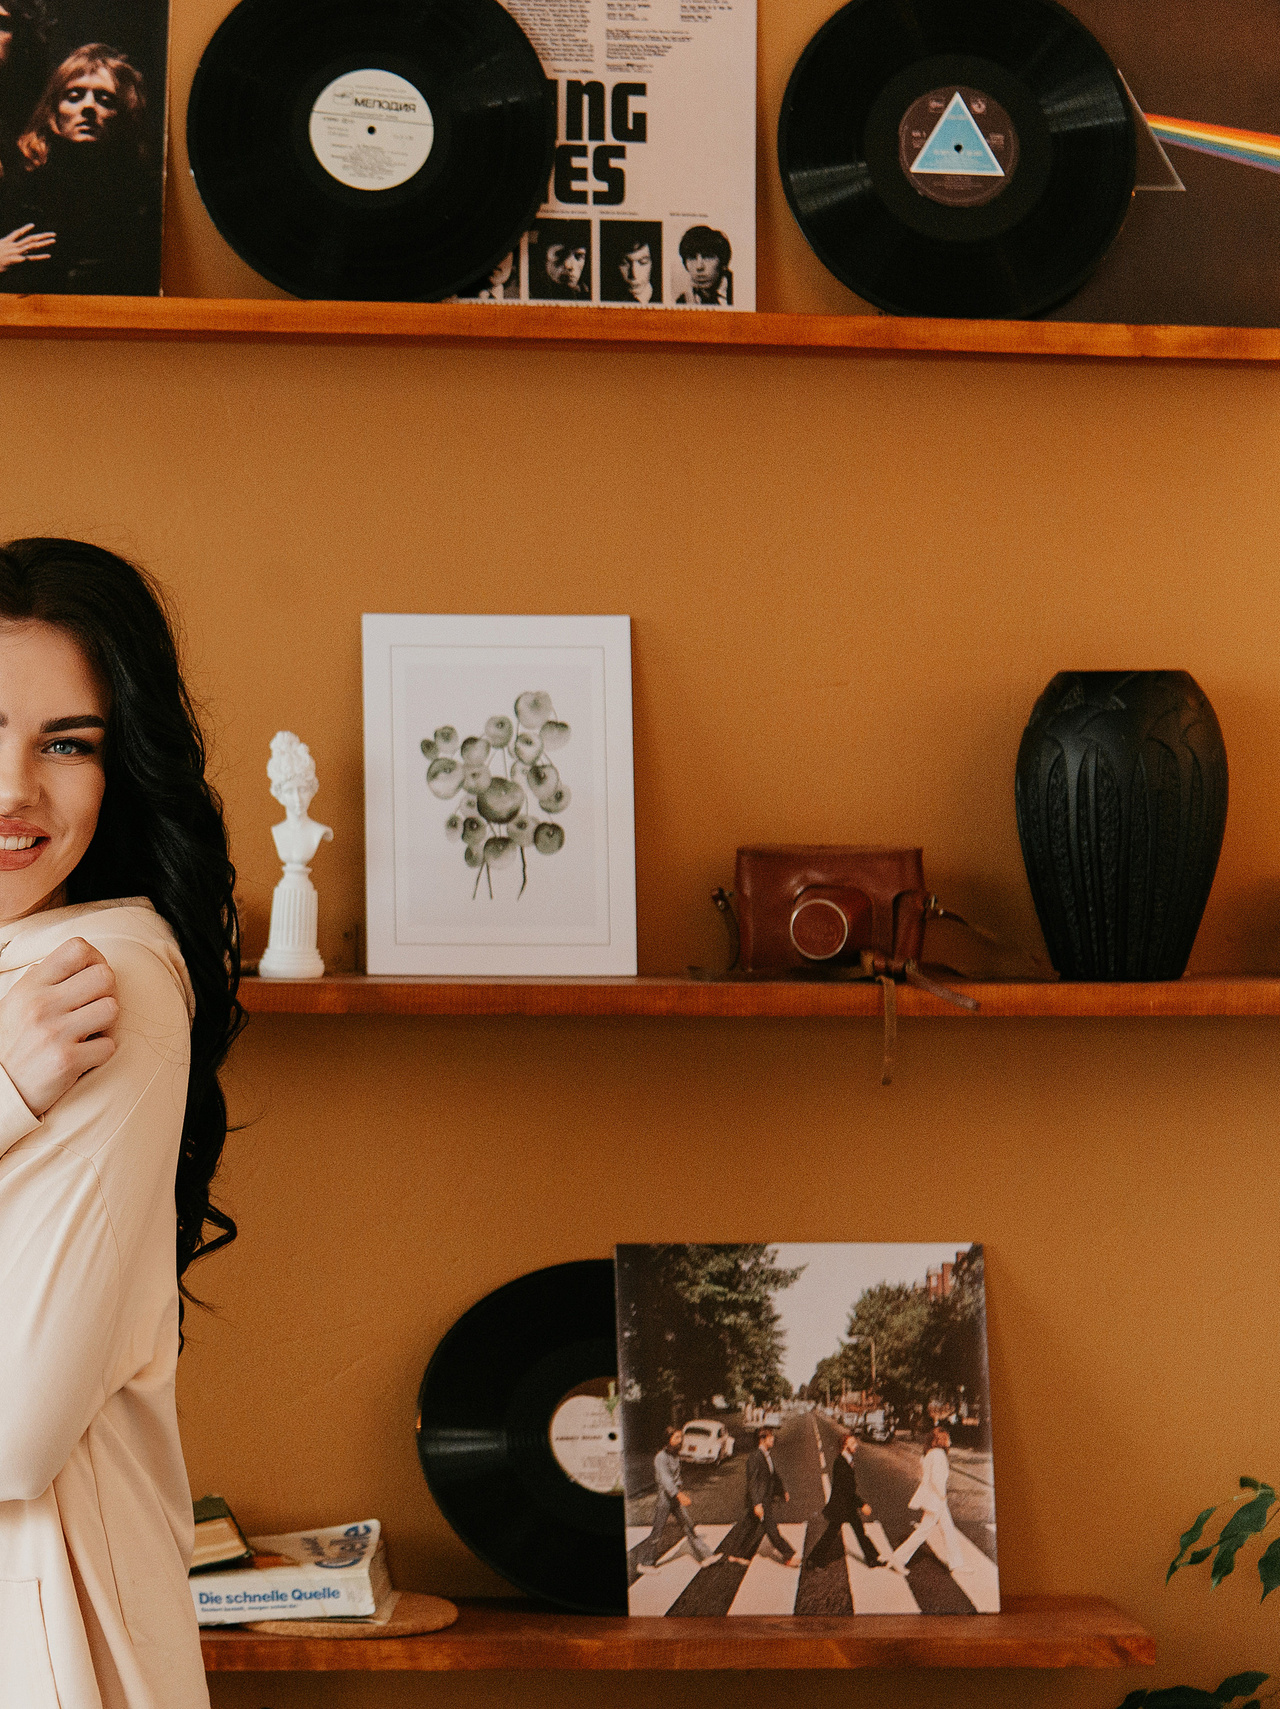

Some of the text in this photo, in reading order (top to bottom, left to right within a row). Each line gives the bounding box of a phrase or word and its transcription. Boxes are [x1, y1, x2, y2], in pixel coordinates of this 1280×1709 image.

[354, 97, 417, 113] МЕЛОДИЯ
[199, 1587, 340, 1604] Die schnelle Quelle
